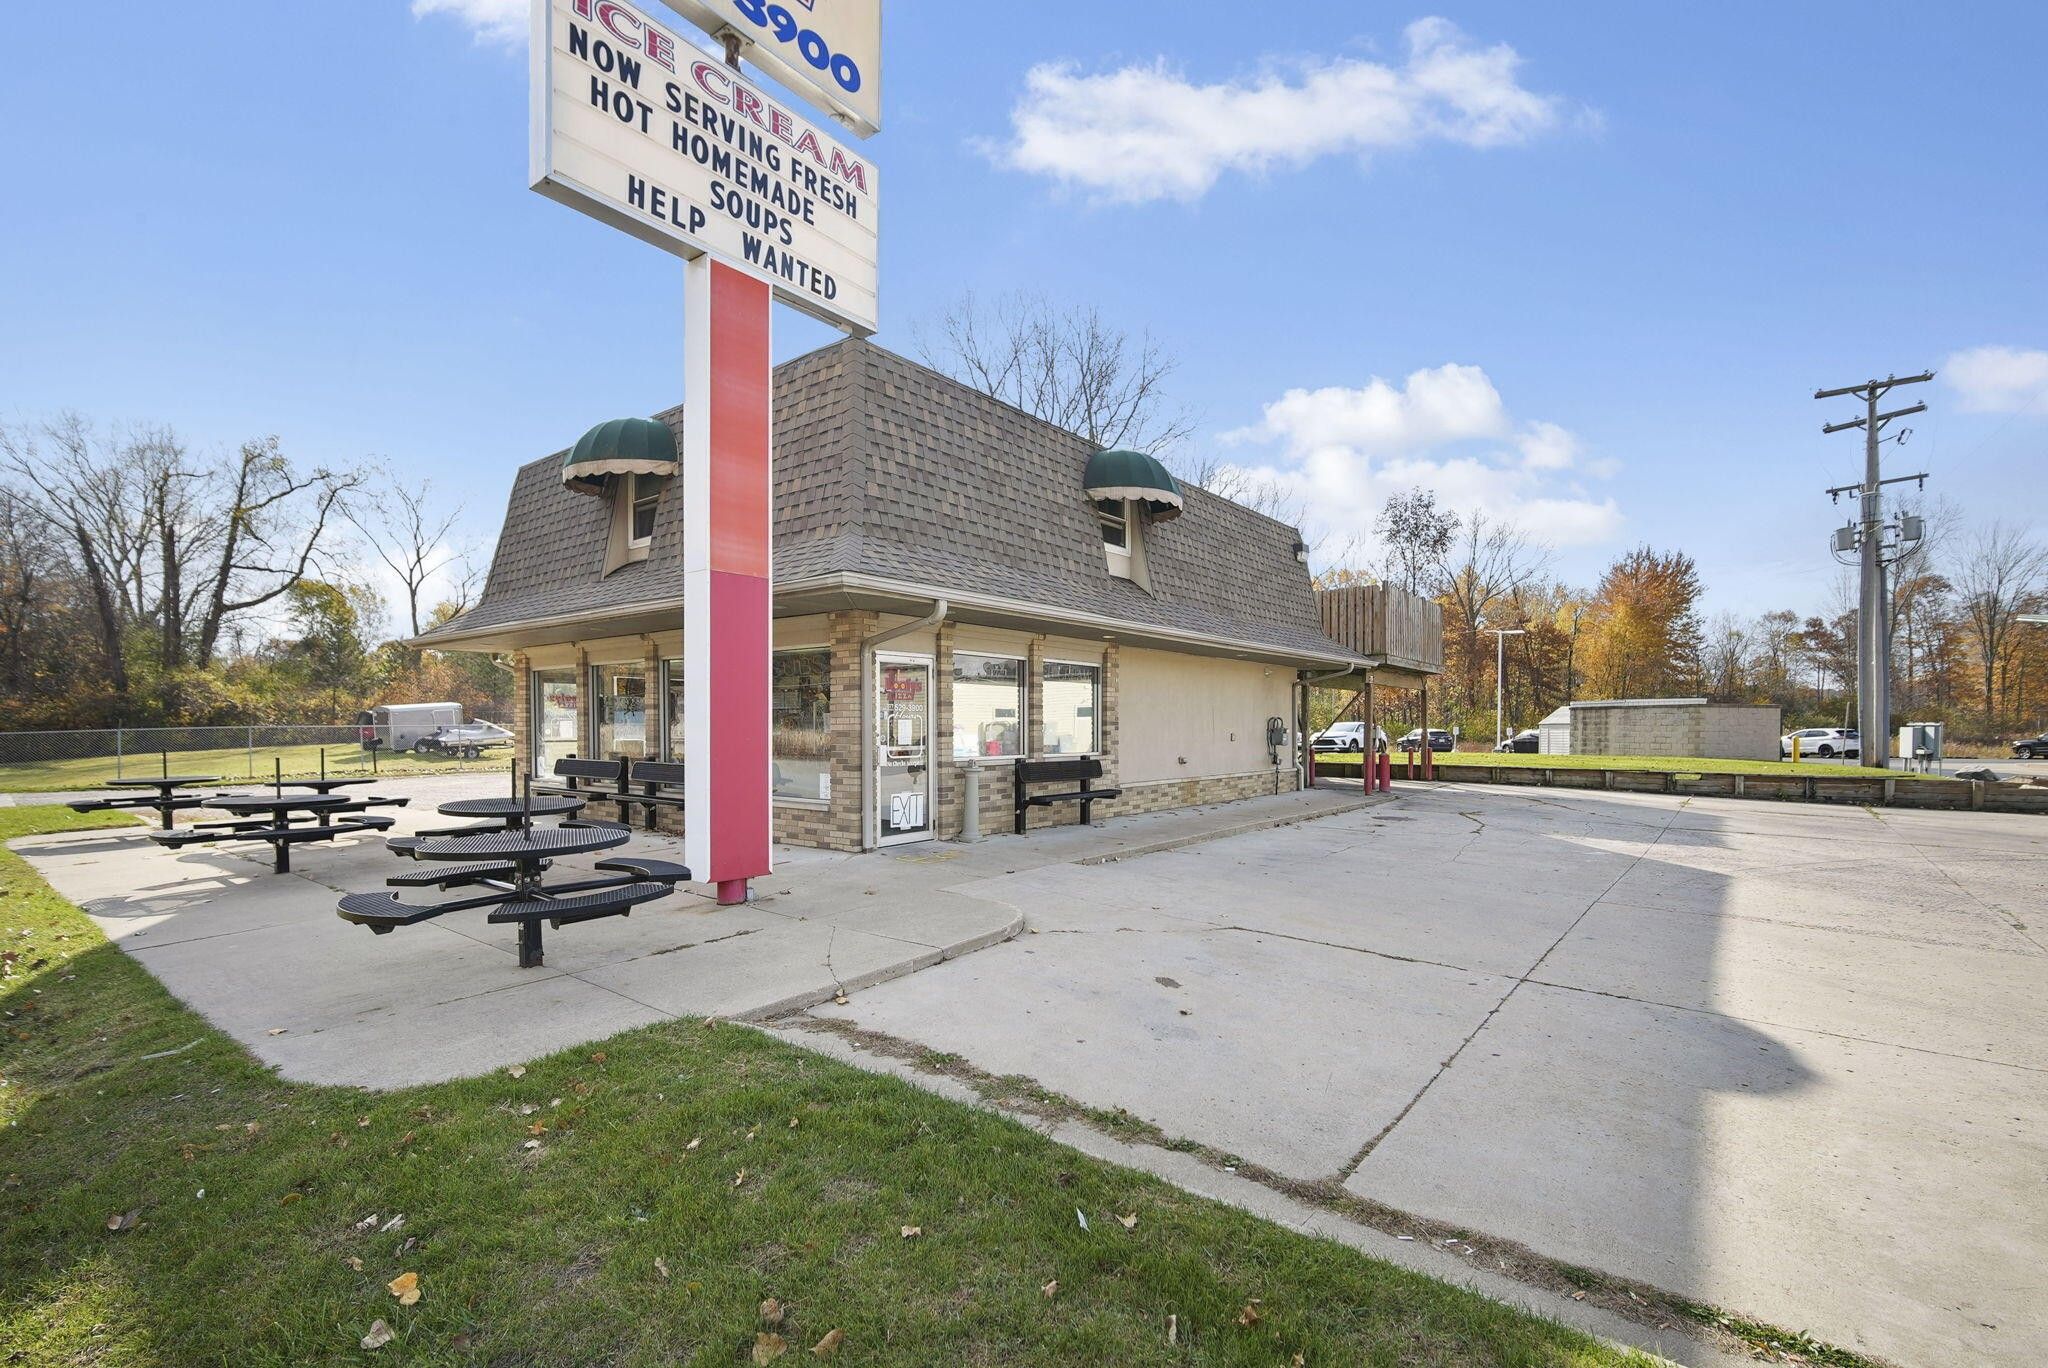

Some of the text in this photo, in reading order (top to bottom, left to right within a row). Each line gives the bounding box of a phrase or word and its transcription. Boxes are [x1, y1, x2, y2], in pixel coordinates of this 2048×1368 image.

[569, 22, 857, 220] NOW SERVING FRESH
[590, 75, 816, 226] HOT HOMEMADE
[691, 61, 868, 195] CREAM
[627, 174, 838, 300] HELP WANTED
[710, 180, 793, 246] SOUPS
[892, 793, 924, 825] EXIT
